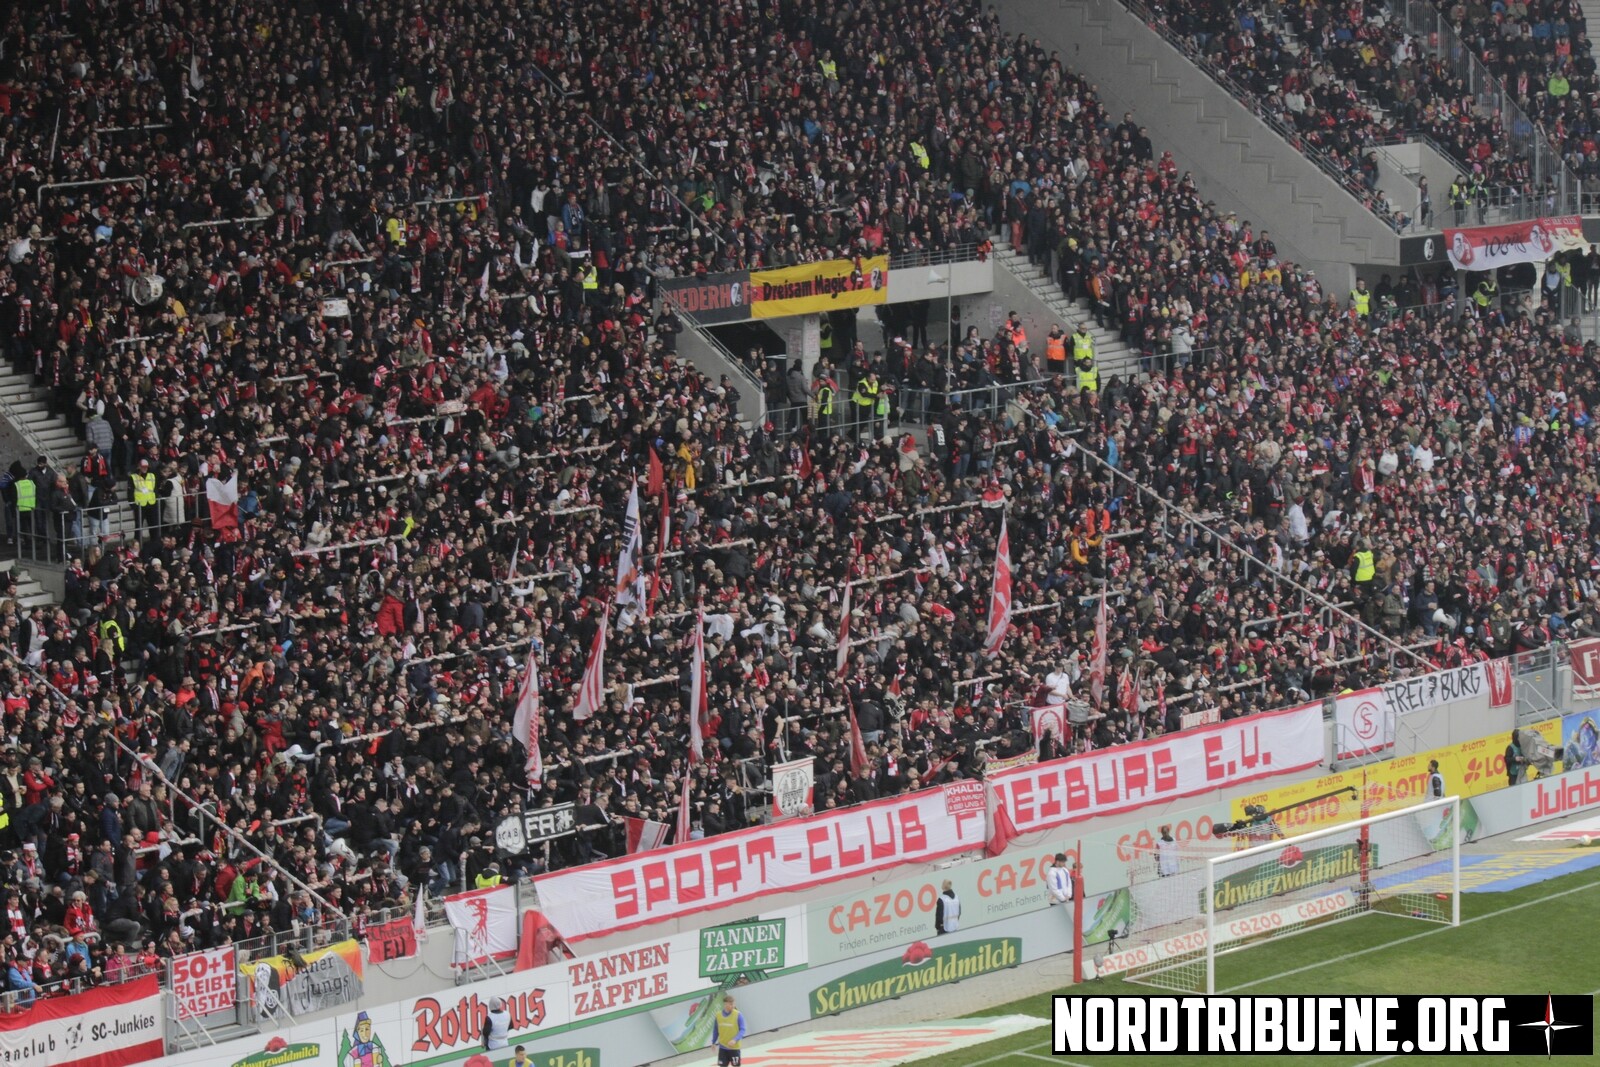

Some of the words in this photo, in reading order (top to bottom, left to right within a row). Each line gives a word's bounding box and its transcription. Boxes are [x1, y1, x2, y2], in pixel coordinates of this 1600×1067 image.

[763, 279, 811, 301] Dreisam
[815, 274, 847, 299] Magic
[1440, 667, 1481, 701] BURG
[1397, 757, 1416, 768] LOTTO
[946, 783, 984, 796] KHALID
[1324, 775, 1344, 787] LOTTO
[1387, 772, 1430, 801] LOTT
[828, 883, 938, 935] CAZOO
[1298, 894, 1347, 919] CAZOO
[703, 922, 782, 949] TANNEN
[1230, 911, 1283, 937] CAZOO
[839, 936, 868, 951] Finden.
[868, 929, 899, 946] Fahren.
[172, 950, 235, 983] 50+1
[569, 942, 671, 987] TANNEN
[706, 946, 779, 972] ZÄPFLE
[815, 938, 1016, 1016] Schwarzwaldmilch
[300, 974, 349, 1011] Jungs
[574, 971, 668, 1016] ZÄPFLE
[411, 987, 547, 1053] Rothus
[0, 1033, 56, 1063] anclub
[91, 1014, 155, 1041] SC-Junkies
